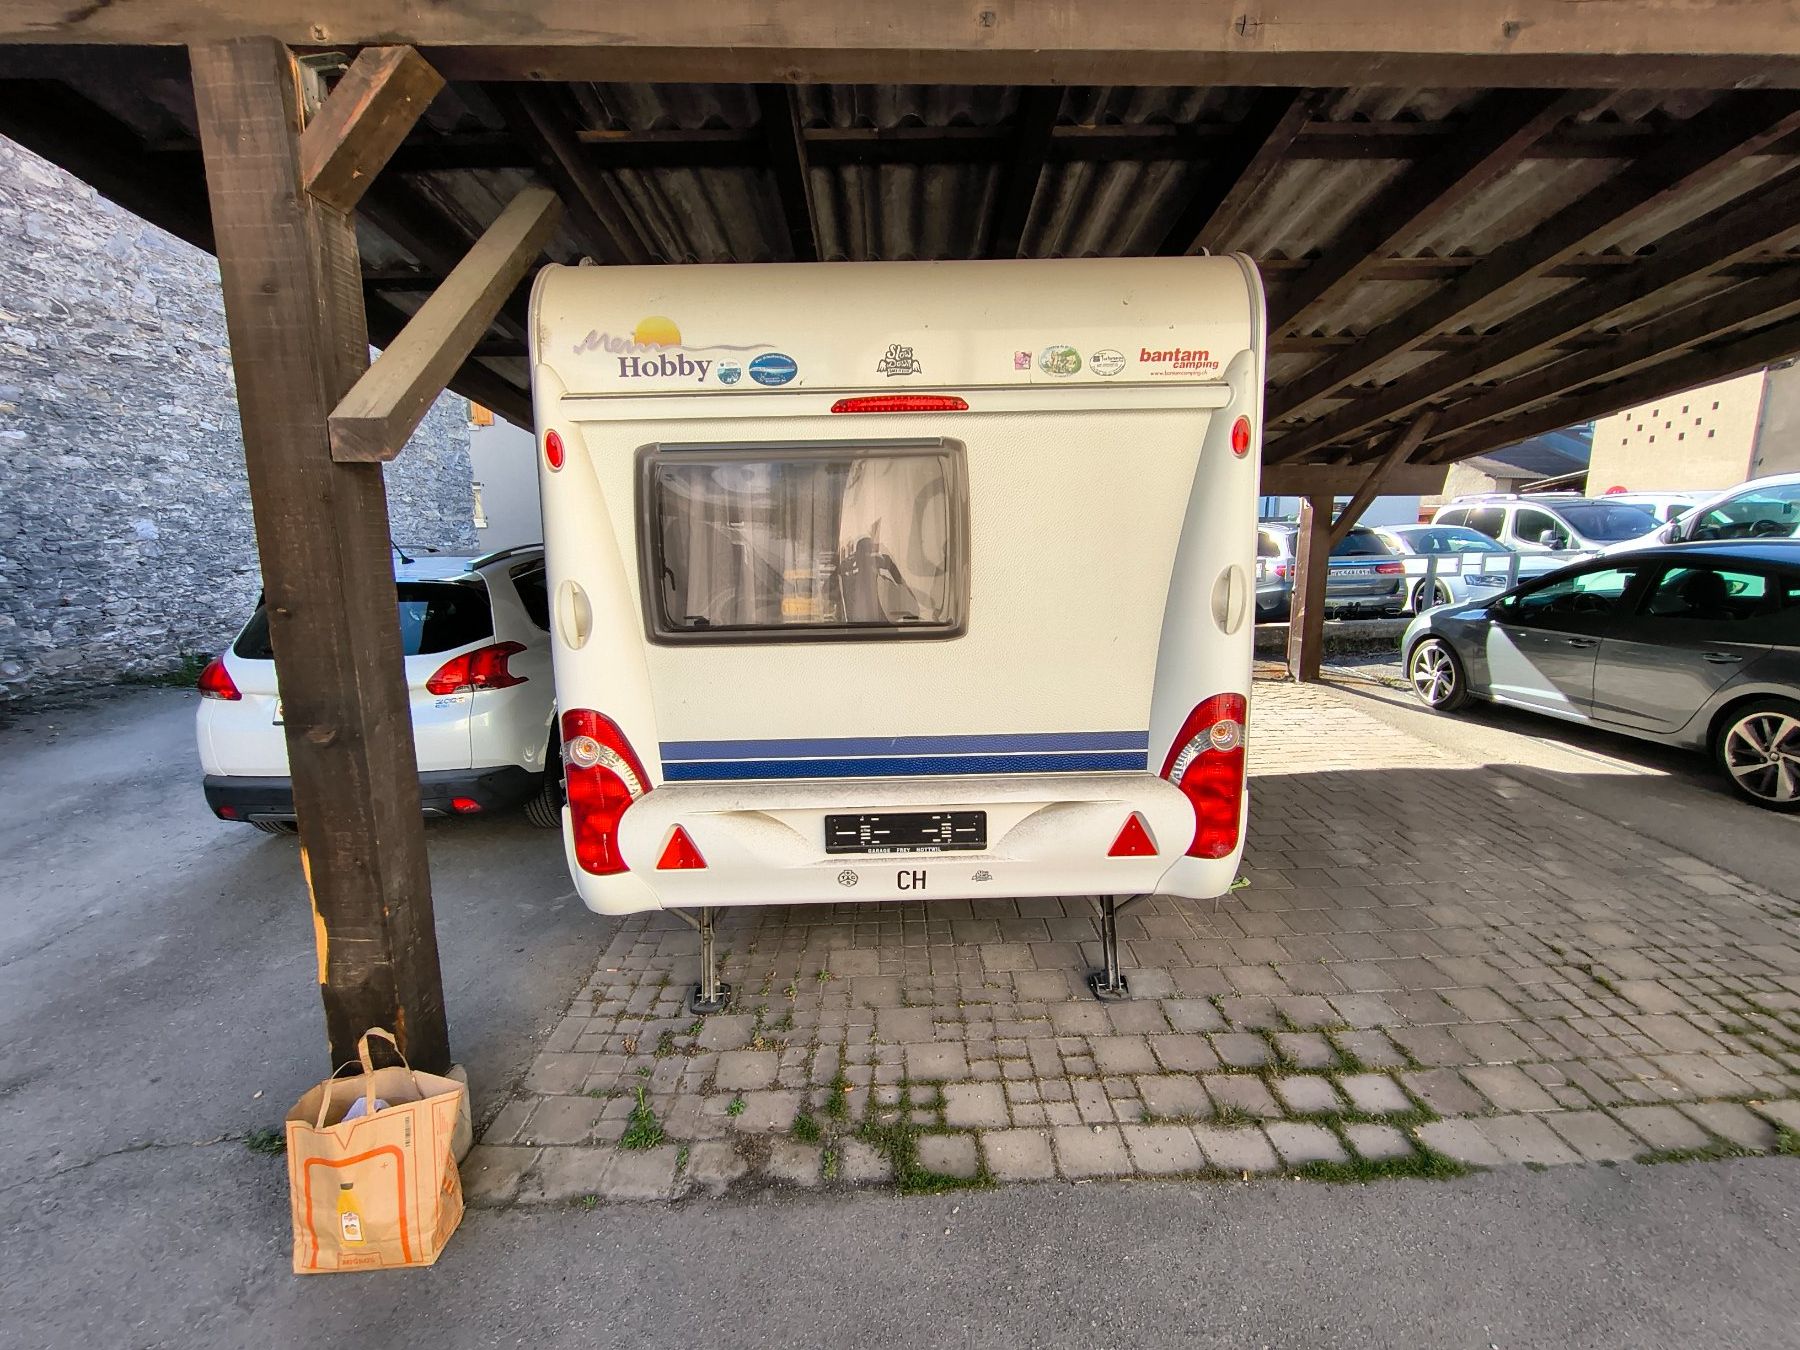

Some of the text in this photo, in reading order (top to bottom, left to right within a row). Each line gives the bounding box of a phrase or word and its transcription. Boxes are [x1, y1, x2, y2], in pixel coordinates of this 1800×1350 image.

[886, 344, 913, 359] Slow
[1140, 348, 1209, 362] bantam
[617, 353, 713, 382] Hobby
[1173, 361, 1219, 370] camping
[897, 870, 927, 890] CH
